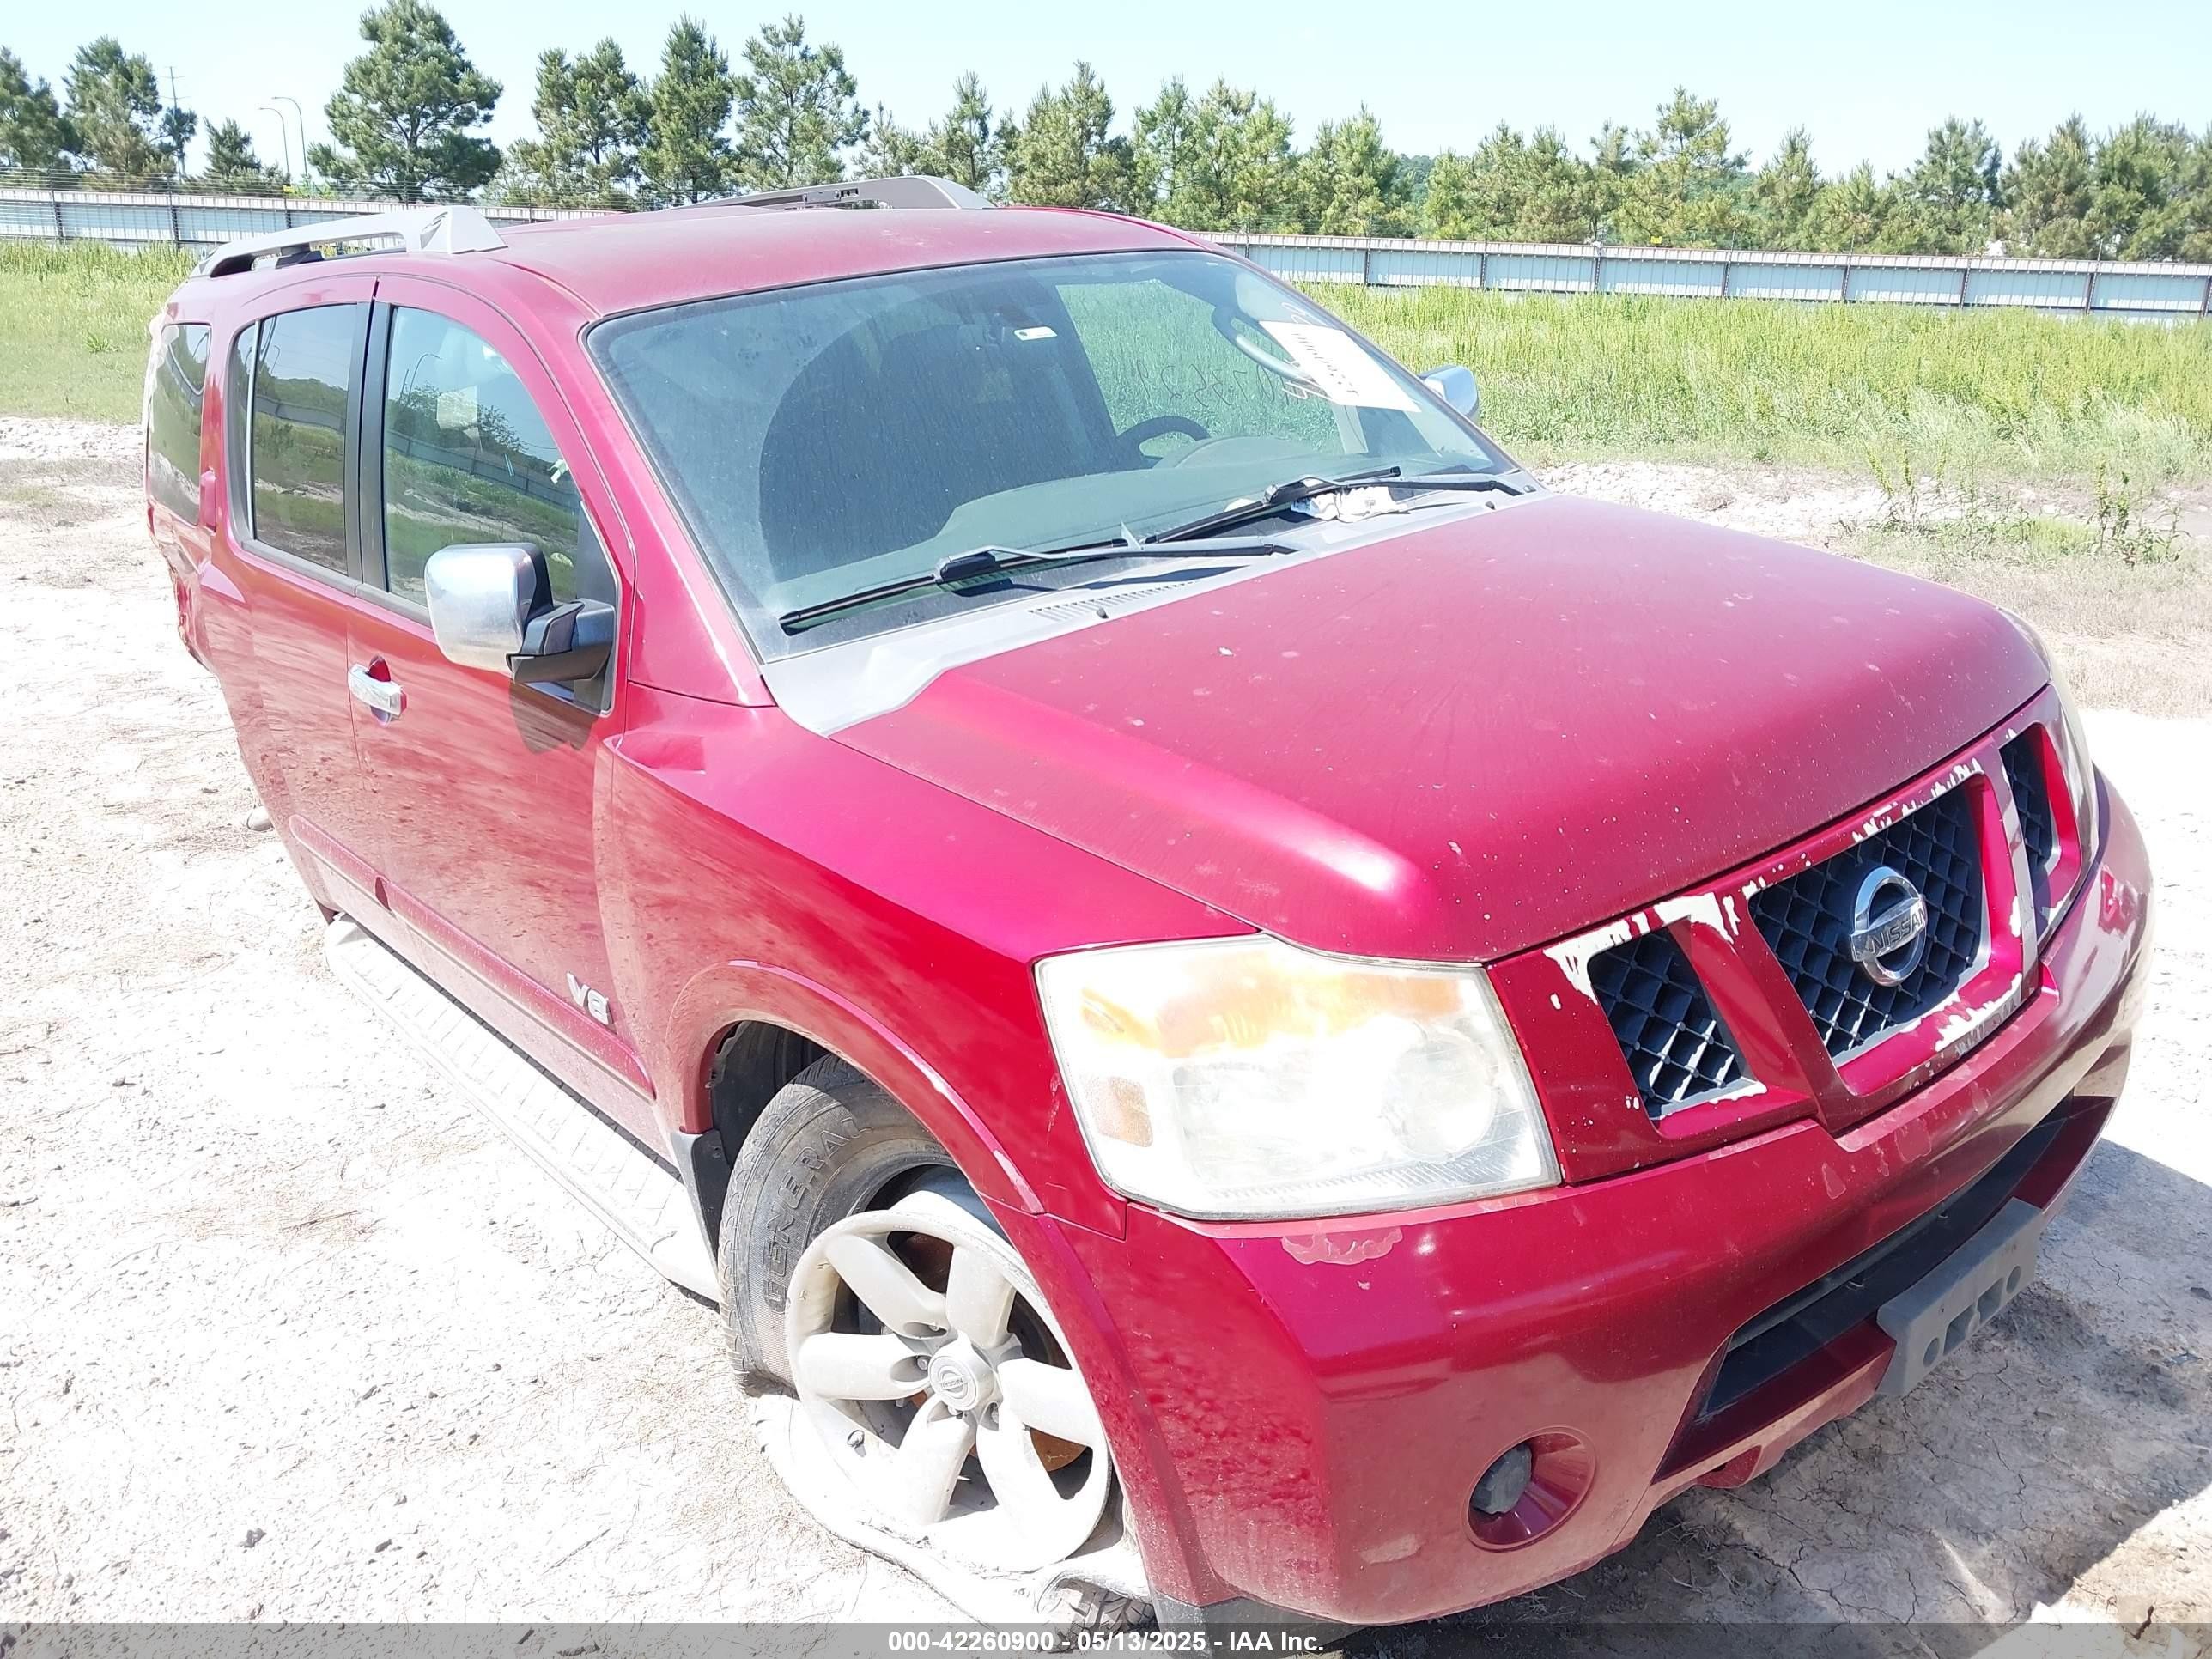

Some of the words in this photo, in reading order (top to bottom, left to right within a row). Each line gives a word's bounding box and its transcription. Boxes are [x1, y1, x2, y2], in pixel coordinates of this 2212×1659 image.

[1867, 906, 1928, 957] NISSAN
[566, 971, 610, 1025] V8
[762, 1116, 874, 1314] GENERAL
